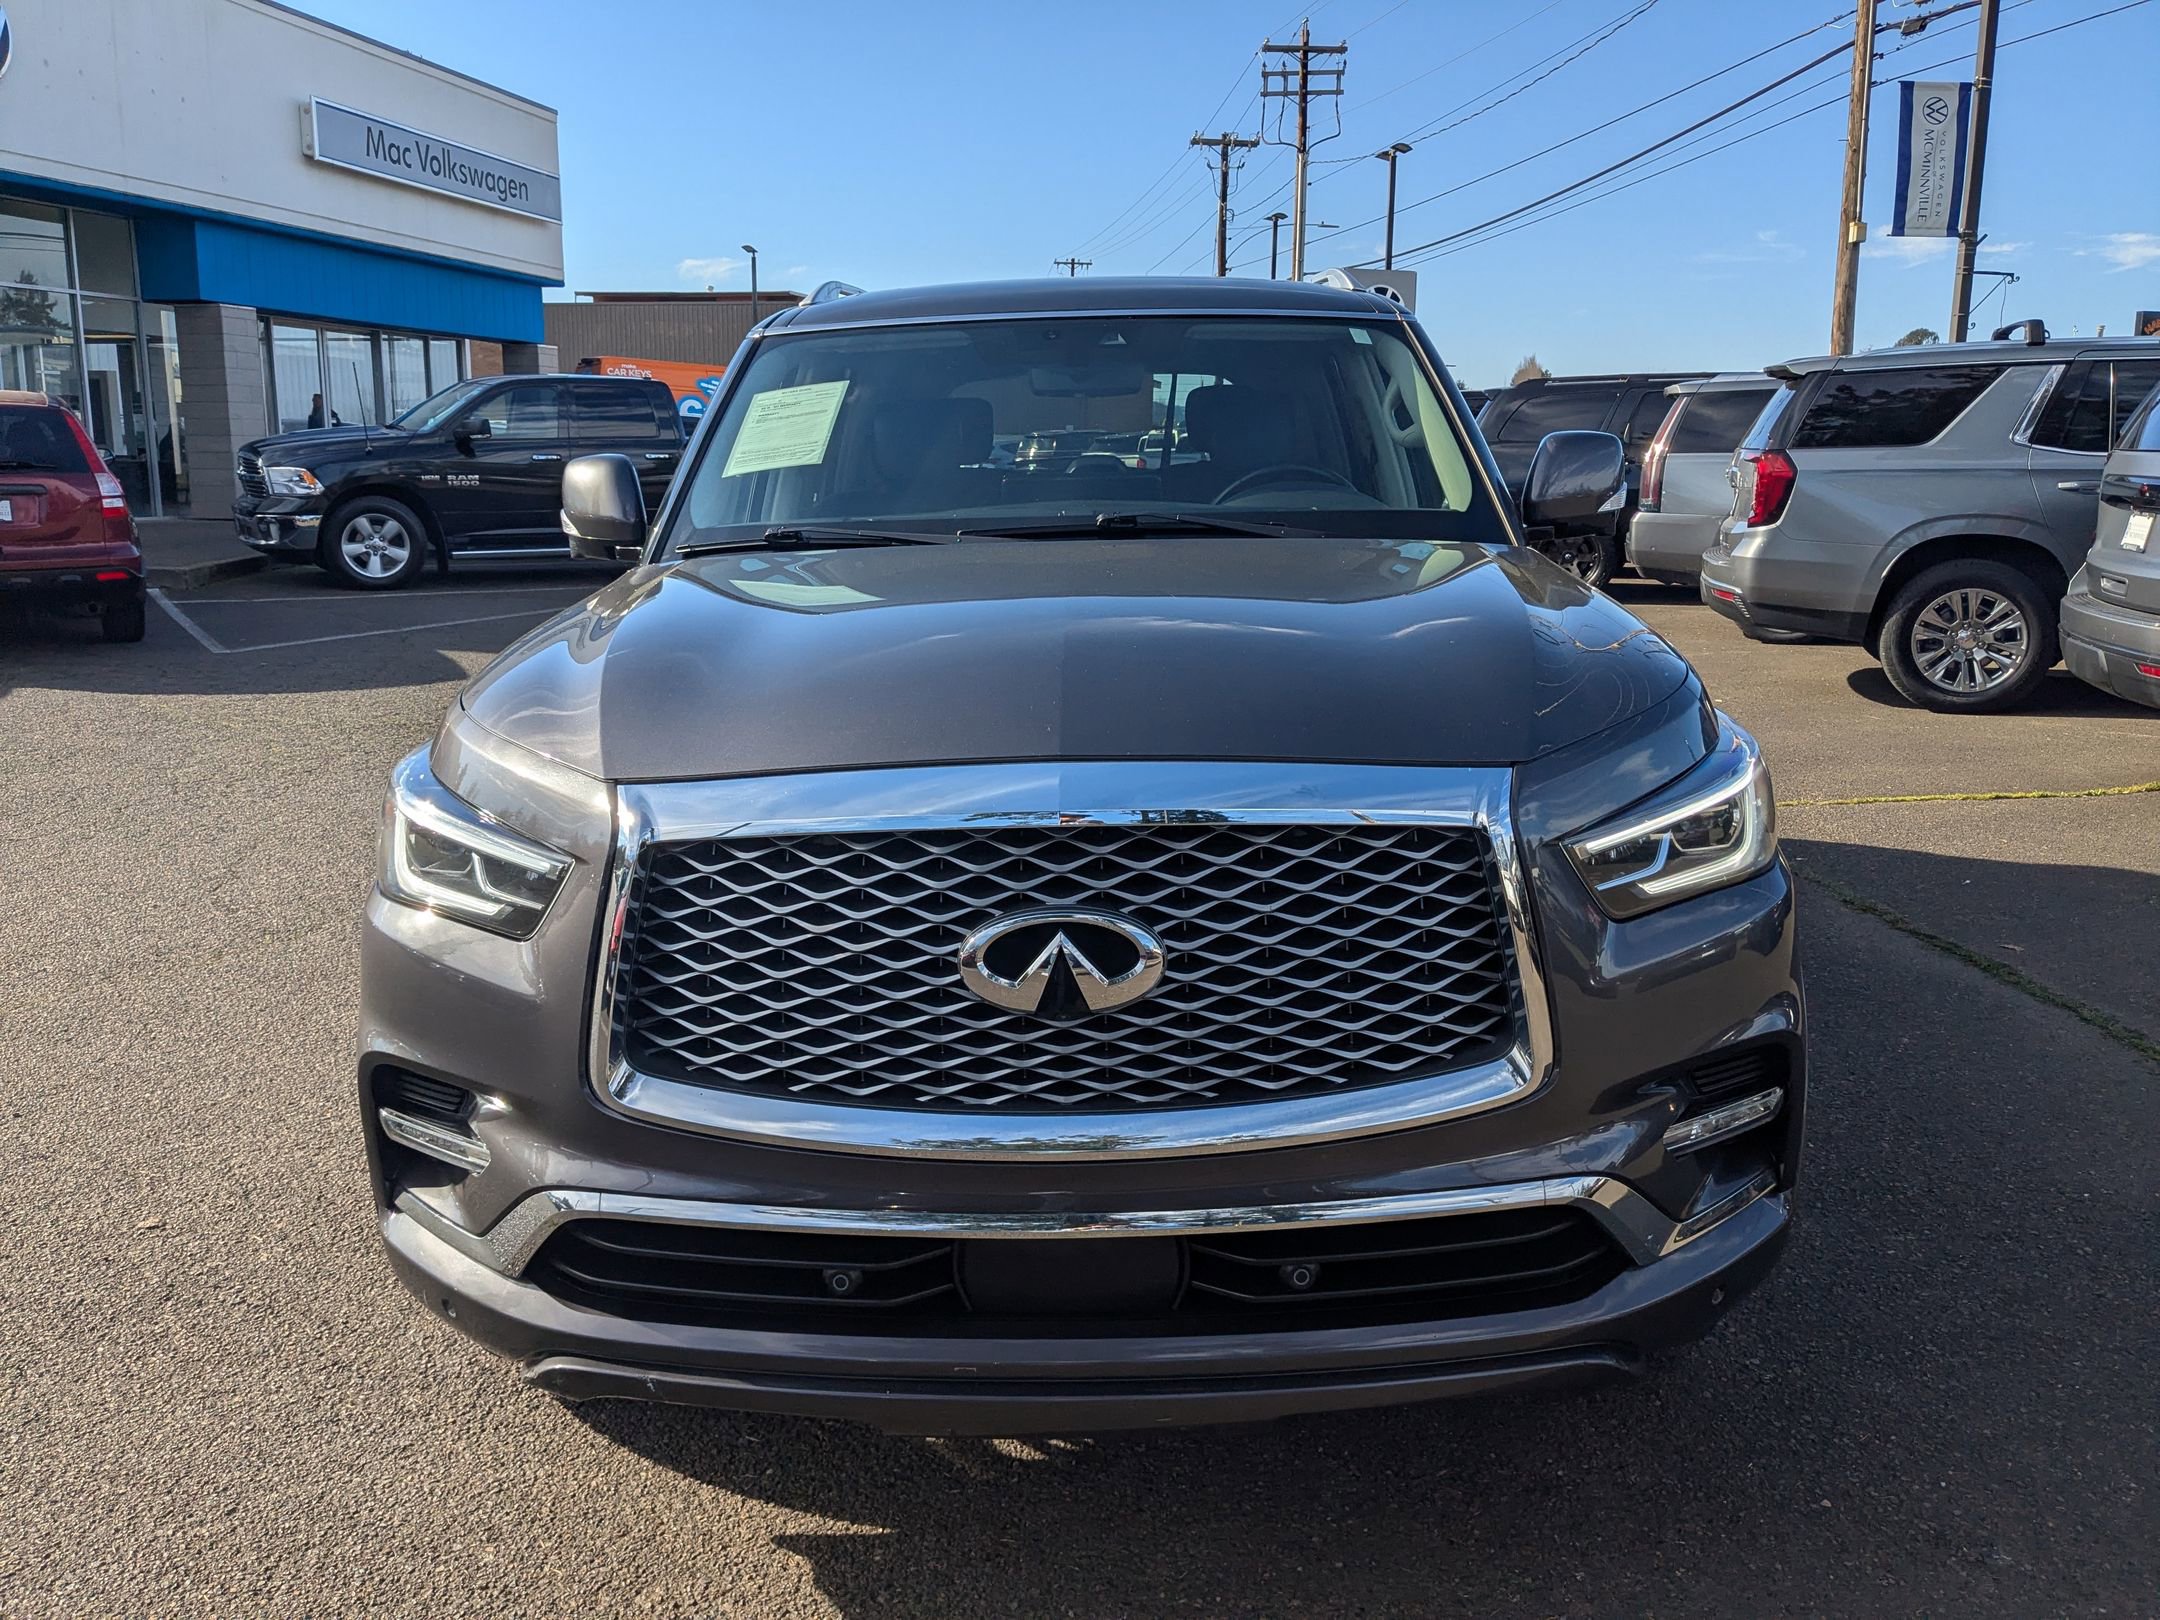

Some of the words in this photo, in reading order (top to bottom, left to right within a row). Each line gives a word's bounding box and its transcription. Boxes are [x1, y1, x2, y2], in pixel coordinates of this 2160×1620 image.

[366, 126, 412, 169] Mac
[415, 140, 529, 202] Volkswagen
[1917, 129, 1935, 222] MCMINNVILLE
[1935, 130, 1947, 217] VOLKSWAGEN
[606, 367, 627, 377] CAR
[628, 369, 652, 378] KEYS
